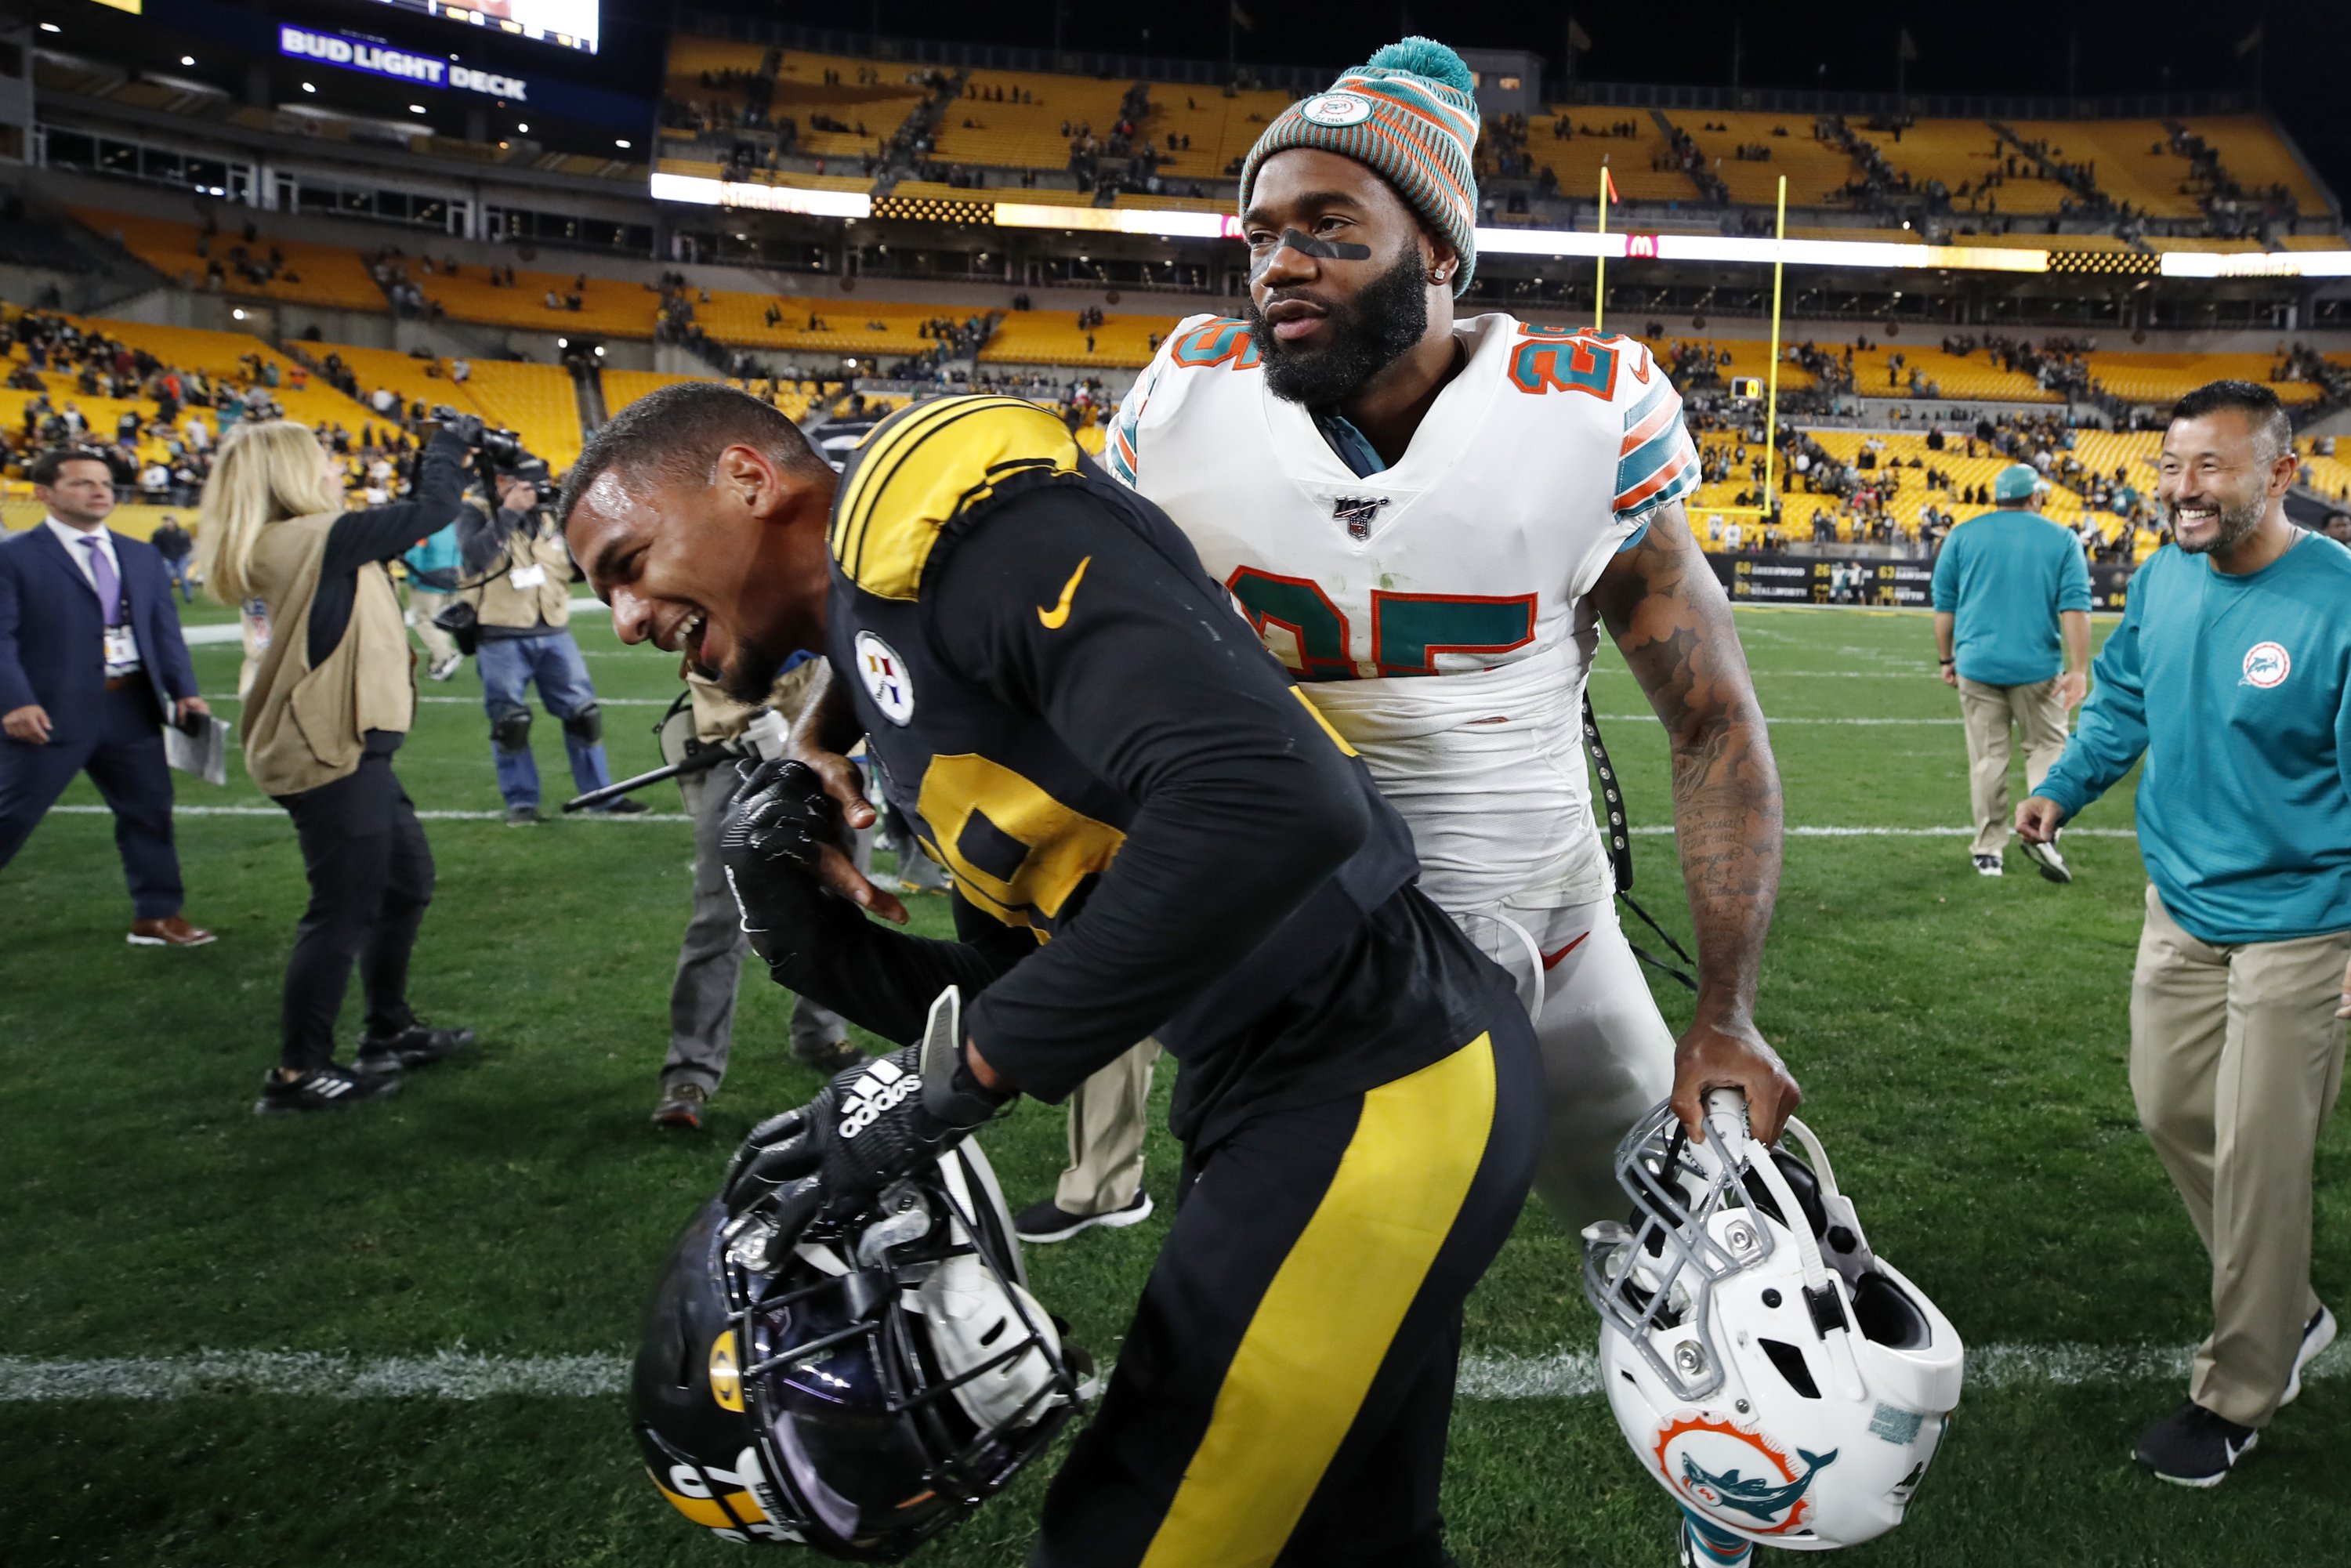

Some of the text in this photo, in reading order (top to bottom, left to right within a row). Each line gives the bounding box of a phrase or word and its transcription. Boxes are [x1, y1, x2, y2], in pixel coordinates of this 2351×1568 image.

[281, 28, 353, 63] BUD
[353, 44, 445, 83] LIGHT
[449, 64, 528, 102] DECK
[839, 1074, 924, 1139] adidas
